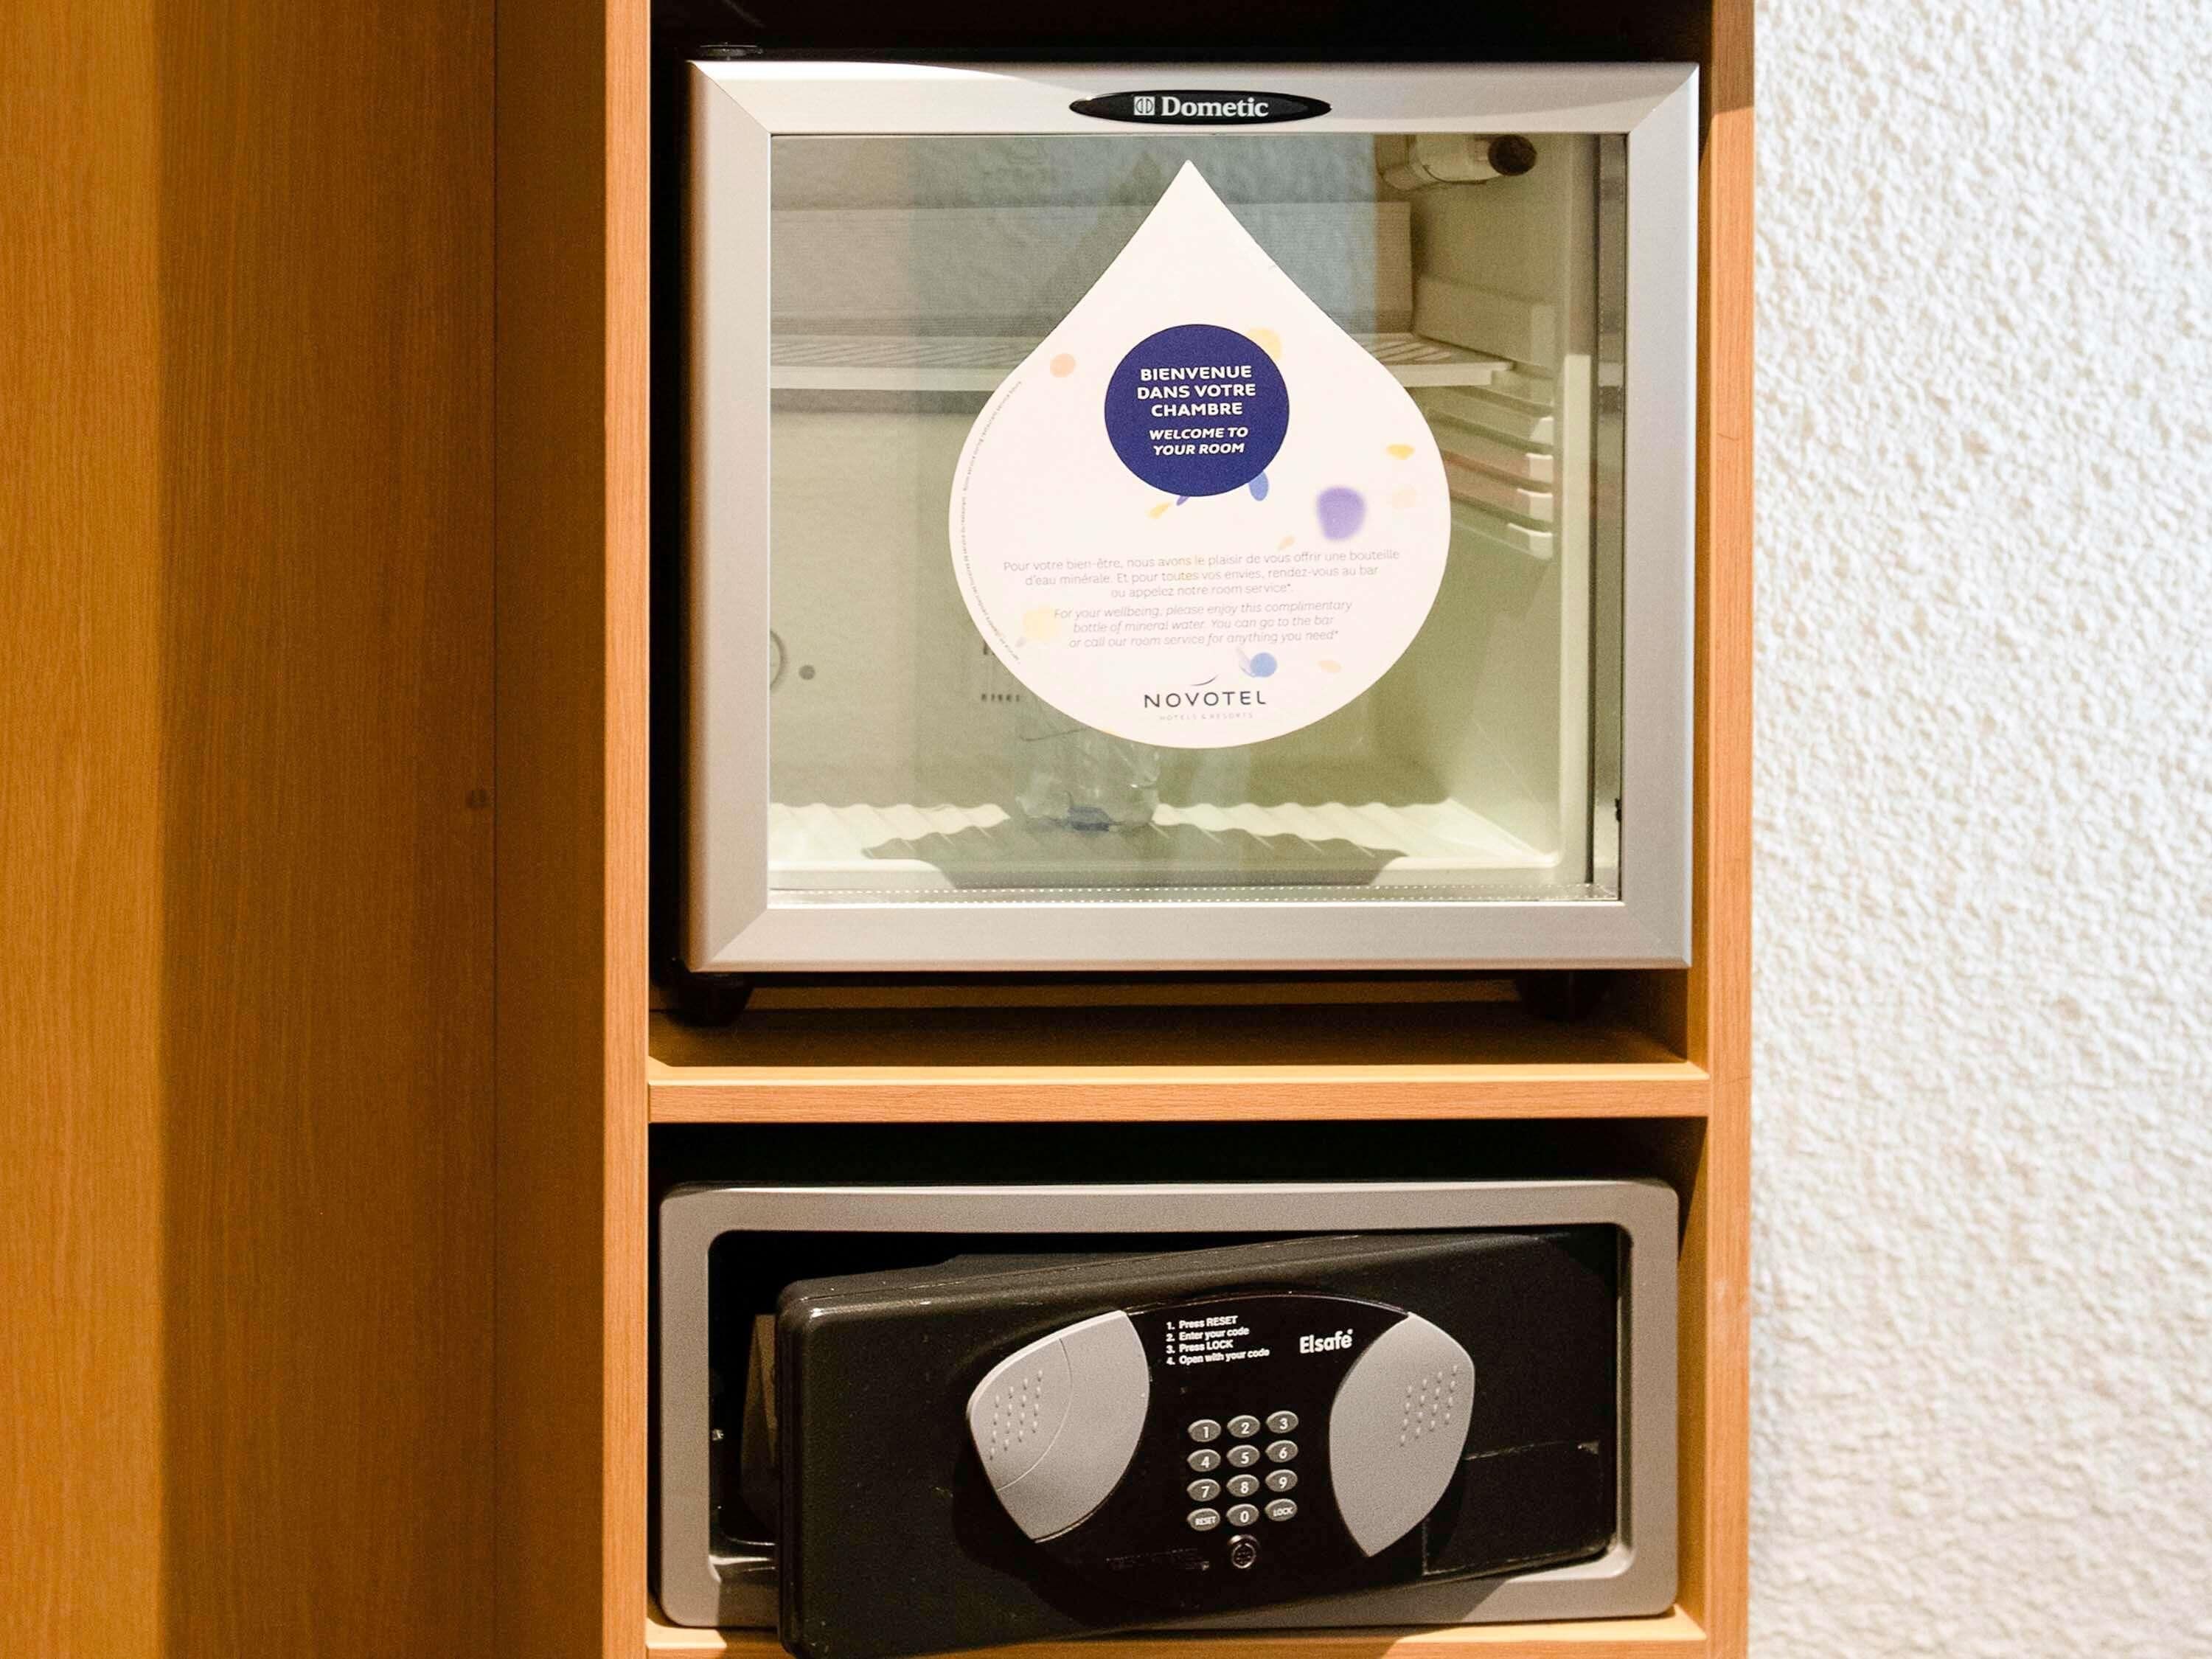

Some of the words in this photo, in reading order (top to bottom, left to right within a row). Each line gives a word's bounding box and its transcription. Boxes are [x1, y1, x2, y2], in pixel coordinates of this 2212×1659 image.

[1161, 96, 1269, 117] Dometic
[1141, 365, 1252, 381] BIENVENUE
[1137, 384, 1190, 400] DANS
[1194, 383, 1256, 397] VOTRE
[1151, 401, 1243, 417] CHAMBRE
[1149, 427, 1225, 441] WELCOME
[1228, 427, 1248, 438] TO
[1152, 443, 1195, 456] YOUR
[1198, 442, 1245, 455] ROOM
[1003, 561, 1029, 571] Pour
[1033, 560, 1063, 570] votre
[1127, 558, 1155, 567] nous
[1158, 557, 1192, 567] avons
[1195, 555, 1204, 566] le
[1208, 554, 1242, 567] plaisir
[1246, 554, 1261, 564] de
[1264, 554, 1290, 563] vous
[1293, 552, 1321, 562] offrir
[1324, 552, 1346, 561] une
[1349, 549, 1399, 560] bouteille
[1116, 573, 1129, 583] Et
[1132, 574, 1158, 585] pour
[1162, 571, 1199, 581] toutes
[1203, 571, 1221, 580] vos
[1267, 567, 1339, 578] rendez-vous
[1342, 566, 1356, 576] au
[1359, 564, 1379, 576] bar
[1110, 589, 1125, 597] ou
[1129, 586, 1174, 599] appelez
[1177, 585, 1208, 597] notre
[1211, 585, 1242, 594] room
[1054, 608, 1074, 619] For
[1074, 610, 1101, 620] your
[1165, 605, 1204, 616] please
[1207, 602, 1238, 616] enjoy
[1241, 602, 1262, 613] this
[1265, 599, 1352, 613] complimentary
[1074, 623, 1107, 633] bottle
[1110, 622, 1123, 635] of
[1125, 620, 1168, 631] mineral
[1211, 618, 1231, 628] You
[1234, 619, 1256, 627] can
[1259, 619, 1273, 630] go
[1278, 617, 1289, 626] to
[1293, 616, 1311, 626] the
[1315, 615, 1333, 625] bar
[1068, 639, 1081, 648] or
[1084, 636, 1105, 647] call
[1108, 637, 1127, 647] our
[1130, 636, 1161, 646] room
[1164, 635, 1205, 645] service
[1207, 633, 1224, 647] for
[1226, 632, 1278, 644] anything
[1280, 633, 1301, 643] you
[1144, 690, 1267, 708] NOVOTEL
[1166, 1321, 1175, 1330] 1.
[1178, 1319, 1205, 1329] Press
[1206, 1315, 1239, 1326] RESET
[1166, 1333, 1175, 1342] 2.
[1178, 1331, 1203, 1341] Enter
[1205, 1330, 1225, 1340] your
[1227, 1326, 1250, 1337] code
[1166, 1345, 1175, 1354] 3.
[1178, 1343, 1205, 1352] Press
[1206, 1339, 1234, 1349] LOCK
[1166, 1357, 1175, 1366] 4.
[1178, 1354, 1203, 1366] Open
[1204, 1352, 1225, 1363] with
[1225, 1352, 1246, 1362] your
[1248, 1348, 1270, 1358] code
[1203, 1427, 1208, 1438] 1
[1241, 1422, 1249, 1434] 2
[1279, 1418, 1287, 1430] 3
[1201, 1456, 1209, 1468] 4
[1241, 1452, 1249, 1464] 5
[1279, 1447, 1287, 1458] 6
[1201, 1486, 1210, 1498] 7
[1241, 1482, 1249, 1493] 8
[1279, 1477, 1287, 1489] 9
[1195, 1517, 1216, 1526] RESET
[1240, 1511, 1249, 1523] 0
[1273, 1507, 1293, 1516] LOCK
